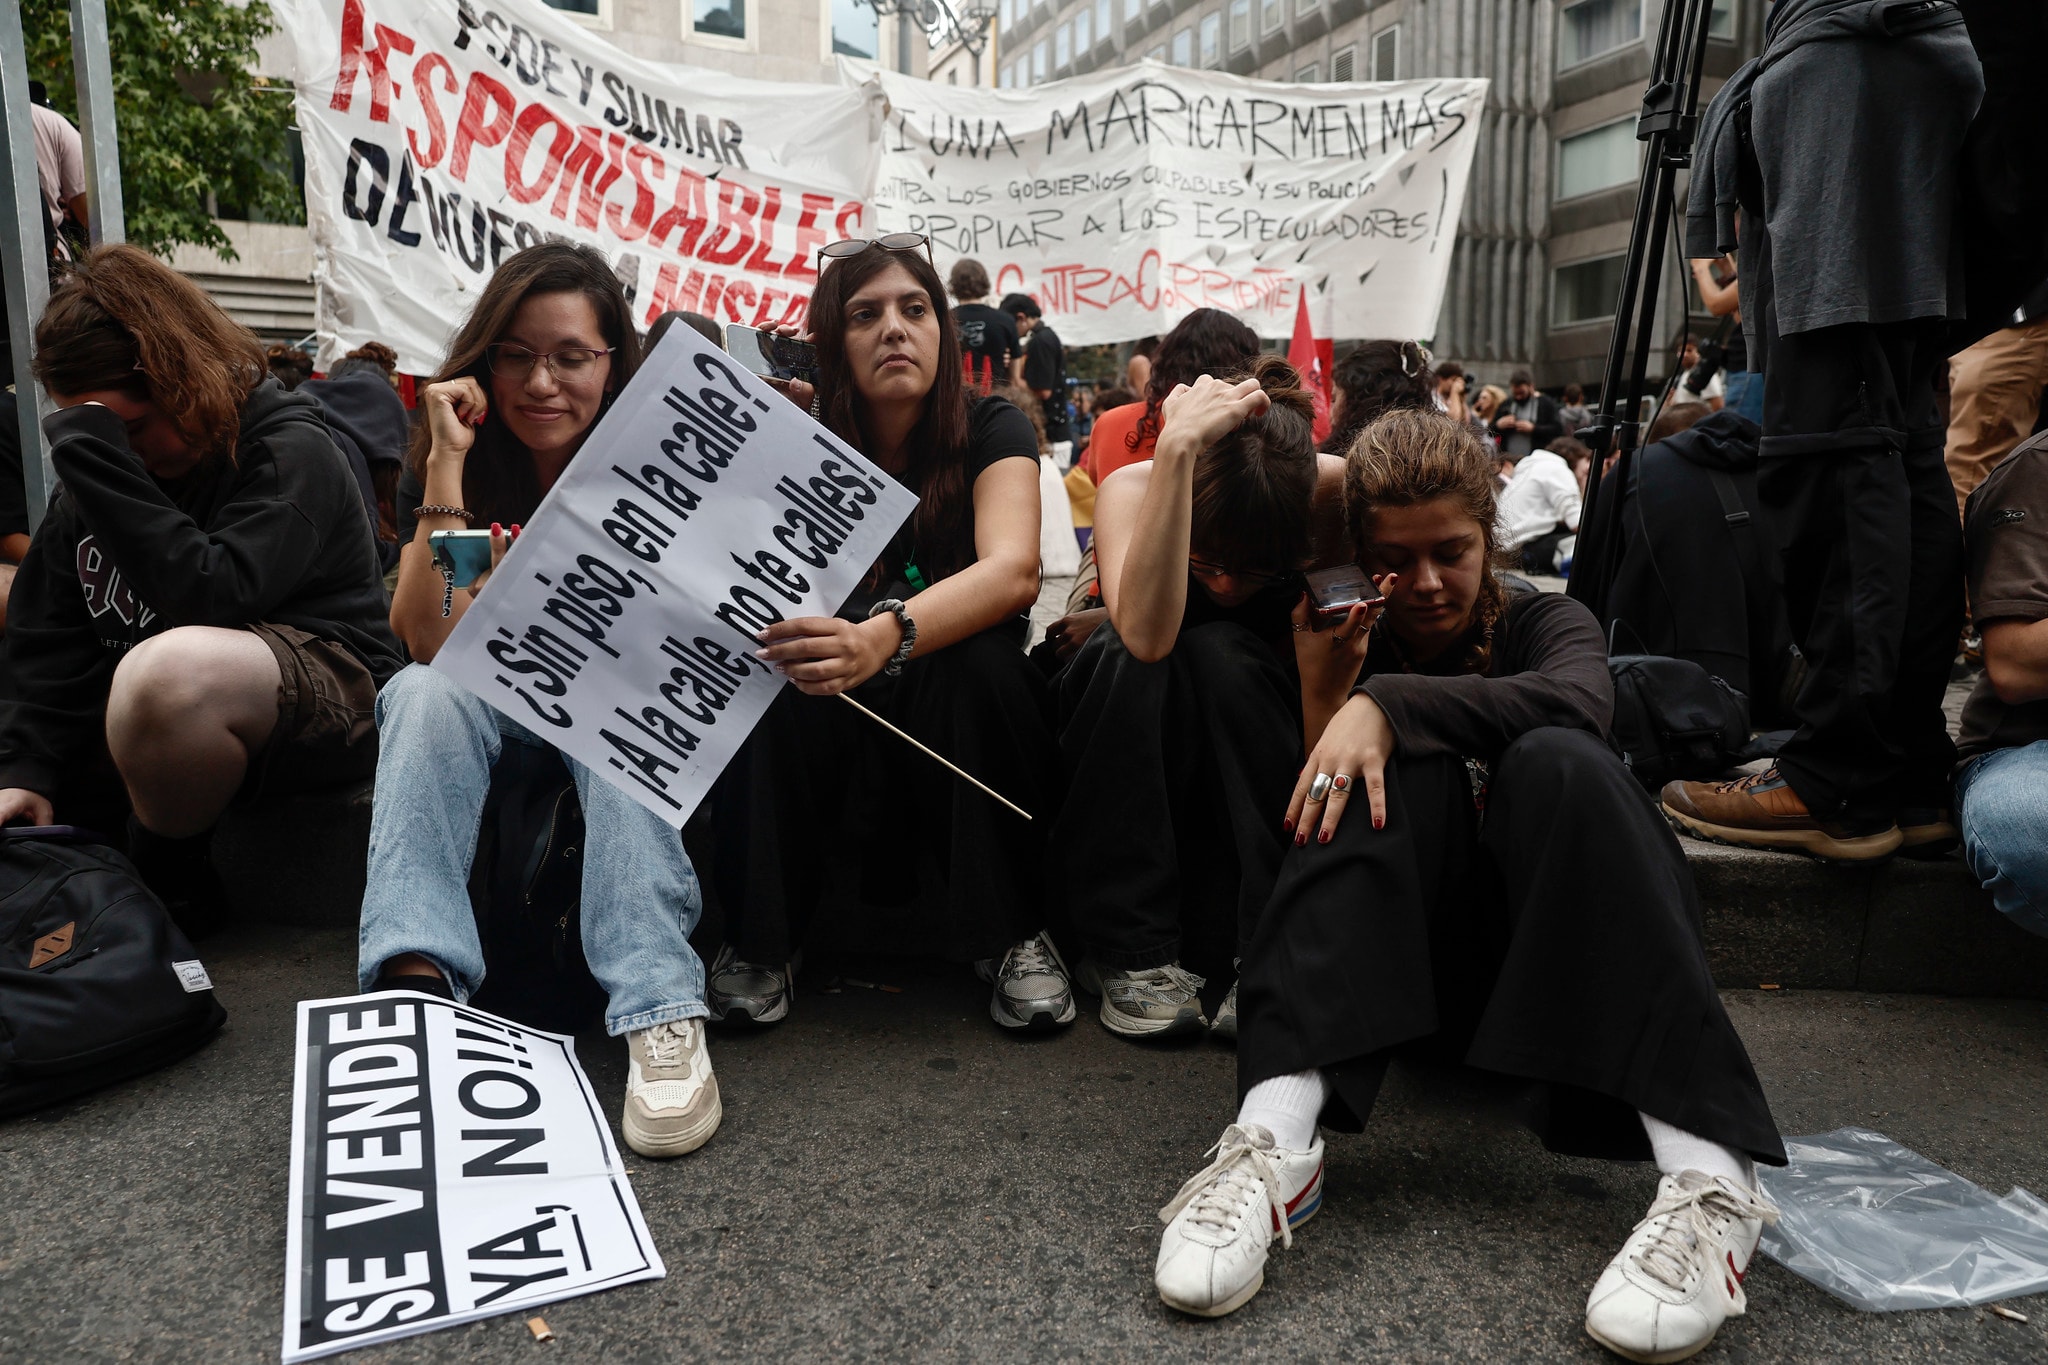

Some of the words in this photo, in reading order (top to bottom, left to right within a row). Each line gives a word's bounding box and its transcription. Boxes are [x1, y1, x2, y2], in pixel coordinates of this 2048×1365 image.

[571, 58, 594, 107] Y
[602, 71, 749, 170] SUMAR
[929, 113, 1025, 161] UNA
[1047, 81, 1368, 161] MARICARMEN
[1381, 82, 1477, 154] MÁS
[946, 186, 993, 205] LOS
[1008, 169, 1132, 204] GOBIERNOS
[1142, 165, 1244, 197] CULPABLES
[1256, 181, 1268, 199] Y
[1273, 182, 1301, 200] SU
[1082, 214, 1107, 236] A
[1118, 198, 1179, 233] LOS
[659, 352, 771, 483] calle?
[601, 497, 677, 563] en
[612, 464, 702, 521] la
[772, 433, 887, 570] calles!
[535, 553, 659, 659] piso,
[713, 584, 786, 648] no
[730, 549, 811, 605] te
[486, 621, 589, 729] ¿Sin
[659, 635, 773, 726] calle,
[598, 725, 682, 811] ¡A
[614, 705, 702, 761] la
[326, 1004, 424, 1229] VENDE
[454, 1010, 549, 1178] NO!!!
[324, 1250, 435, 1333] SE
[467, 1204, 573, 1309] YA,
